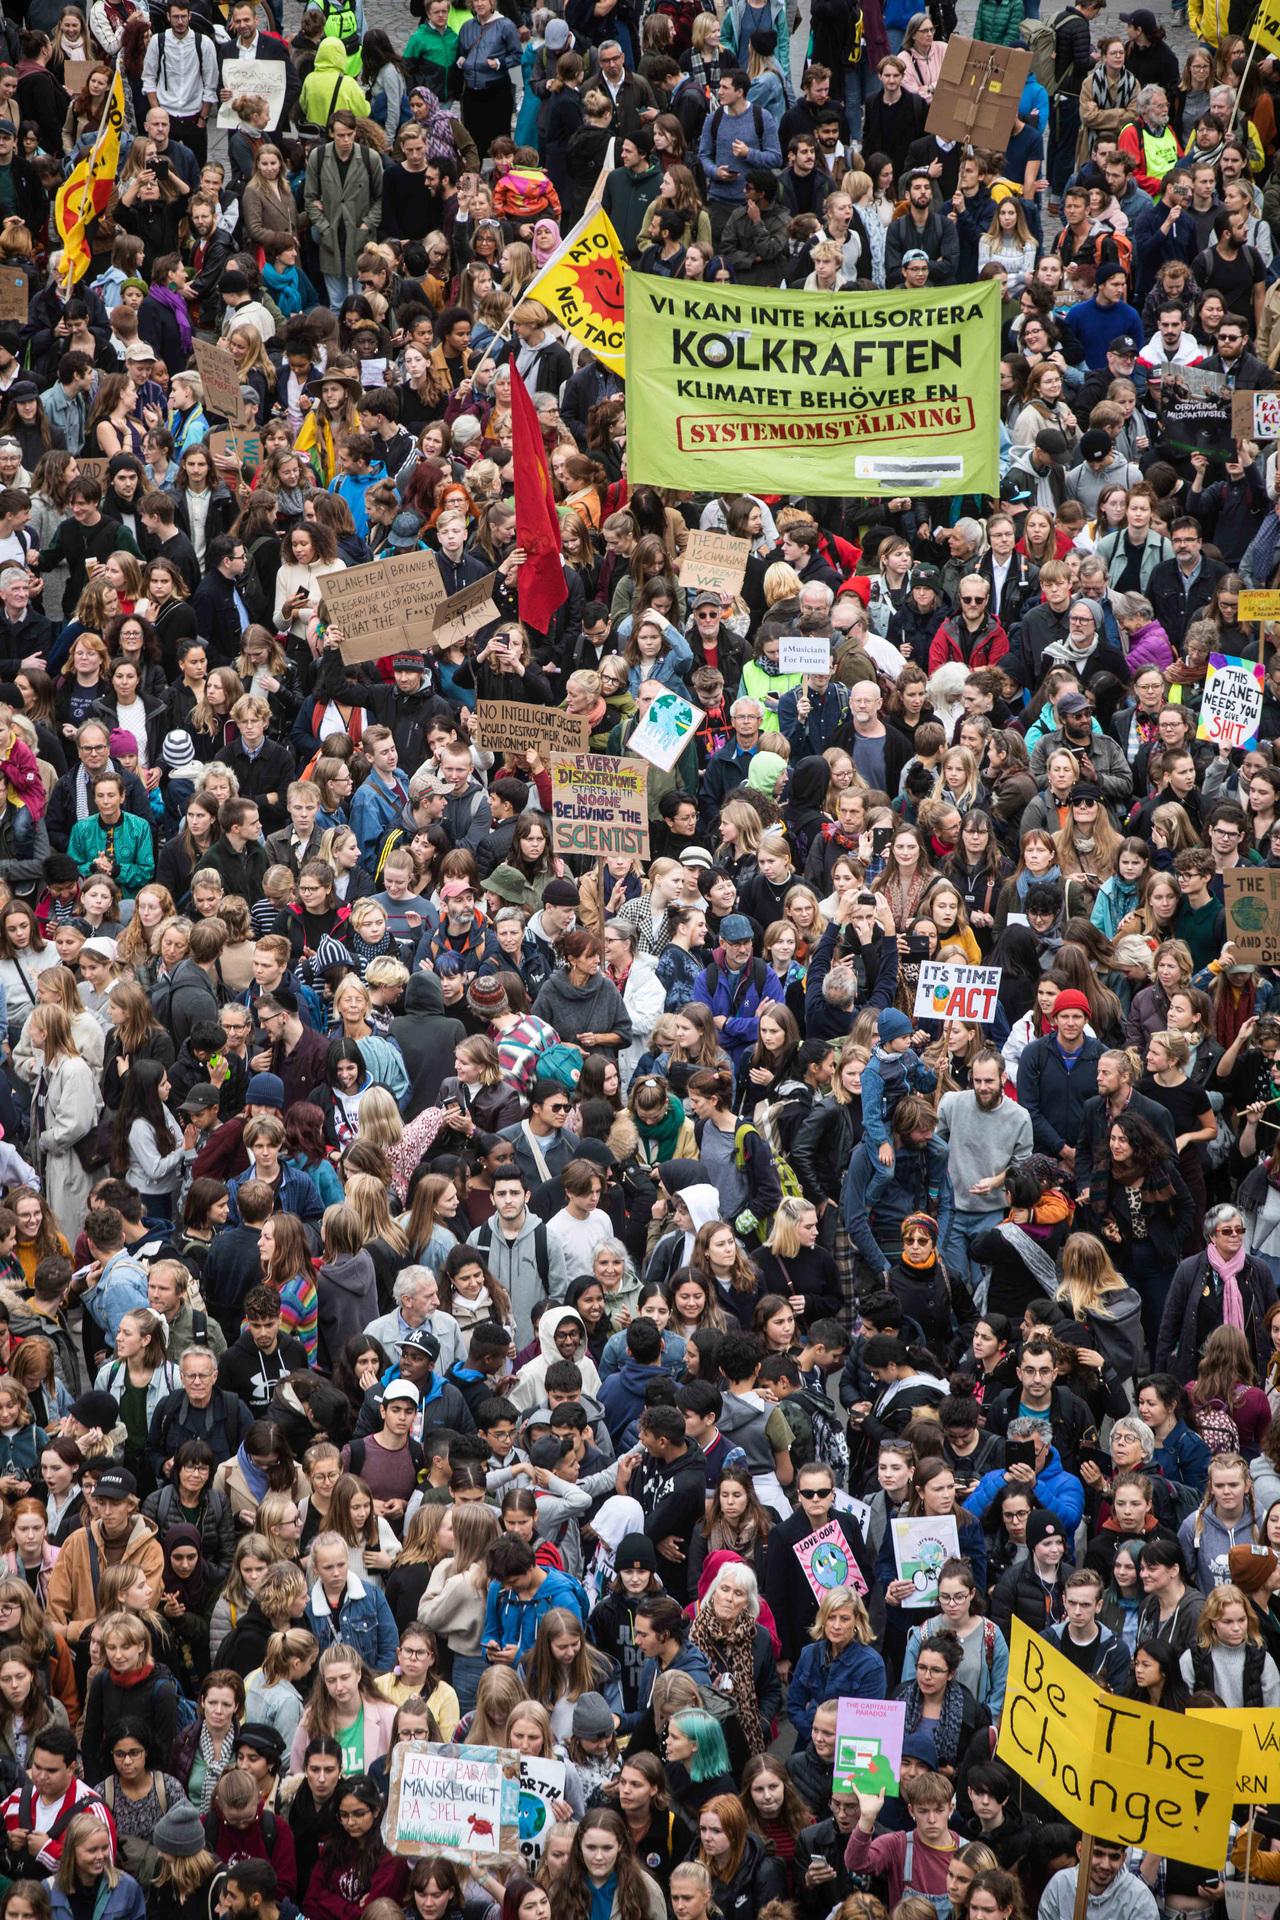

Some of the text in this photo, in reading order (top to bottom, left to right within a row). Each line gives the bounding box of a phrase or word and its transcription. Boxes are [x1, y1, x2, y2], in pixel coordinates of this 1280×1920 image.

[568, 233, 609, 262] ATO
[555, 286, 624, 349] NEJ TAC
[649, 294, 984, 328] VI KAN INTE KÄLLSORTERA
[673, 328, 962, 378] KOLKRAFTEN
[677, 380, 958, 408] KLIMATET BEHÖVER EN
[690, 406, 962, 443] SYSTEMOMSTÄLLNING
[712, 537, 748, 553] CLIMATE
[326, 560, 436, 595] PLANETEN BRINNER
[697, 574, 724, 587] WE
[337, 608, 367, 625] REFORM
[372, 614, 395, 629] THE
[800, 656, 825, 664] Future
[1226, 670, 1248, 684] THIS
[1212, 678, 1264, 705] PLANET
[1204, 692, 1257, 718] NEEDS YOU
[1210, 707, 1220, 716] TO
[1224, 711, 1239, 721] GIVE
[480, 704, 582, 734] NO INTELLIGENT SPECIES
[1210, 716, 1246, 745] SHIT
[479, 723, 580, 748] WOULD DESTROY THEIR OWN
[576, 755, 621, 773] EVERY
[572, 785, 632, 798] STARTS WITH
[619, 809, 642, 824] THE
[556, 823, 647, 855] SCIENTIST
[1237, 877, 1265, 892] THE
[1265, 937, 1277, 949] SO
[954, 968, 998, 985] TIME
[946, 987, 997, 1019] ACT
[800, 1525, 834, 1552] LOVE OUR
[860, 1703, 897, 1711] CAPITALIST
[1024, 1639, 1204, 1780] Be The
[1253, 1722, 1280, 1751] VÅ
[410, 1758, 489, 1783] INTE BARA
[1011, 1695, 1210, 1844] Change!
[403, 1778, 500, 1807] MÄNSKLIGHET
[519, 1777, 561, 1800] ARTH
[1236, 1776, 1267, 1793] ARN
[401, 1799, 462, 1822] PÅ SPEL
